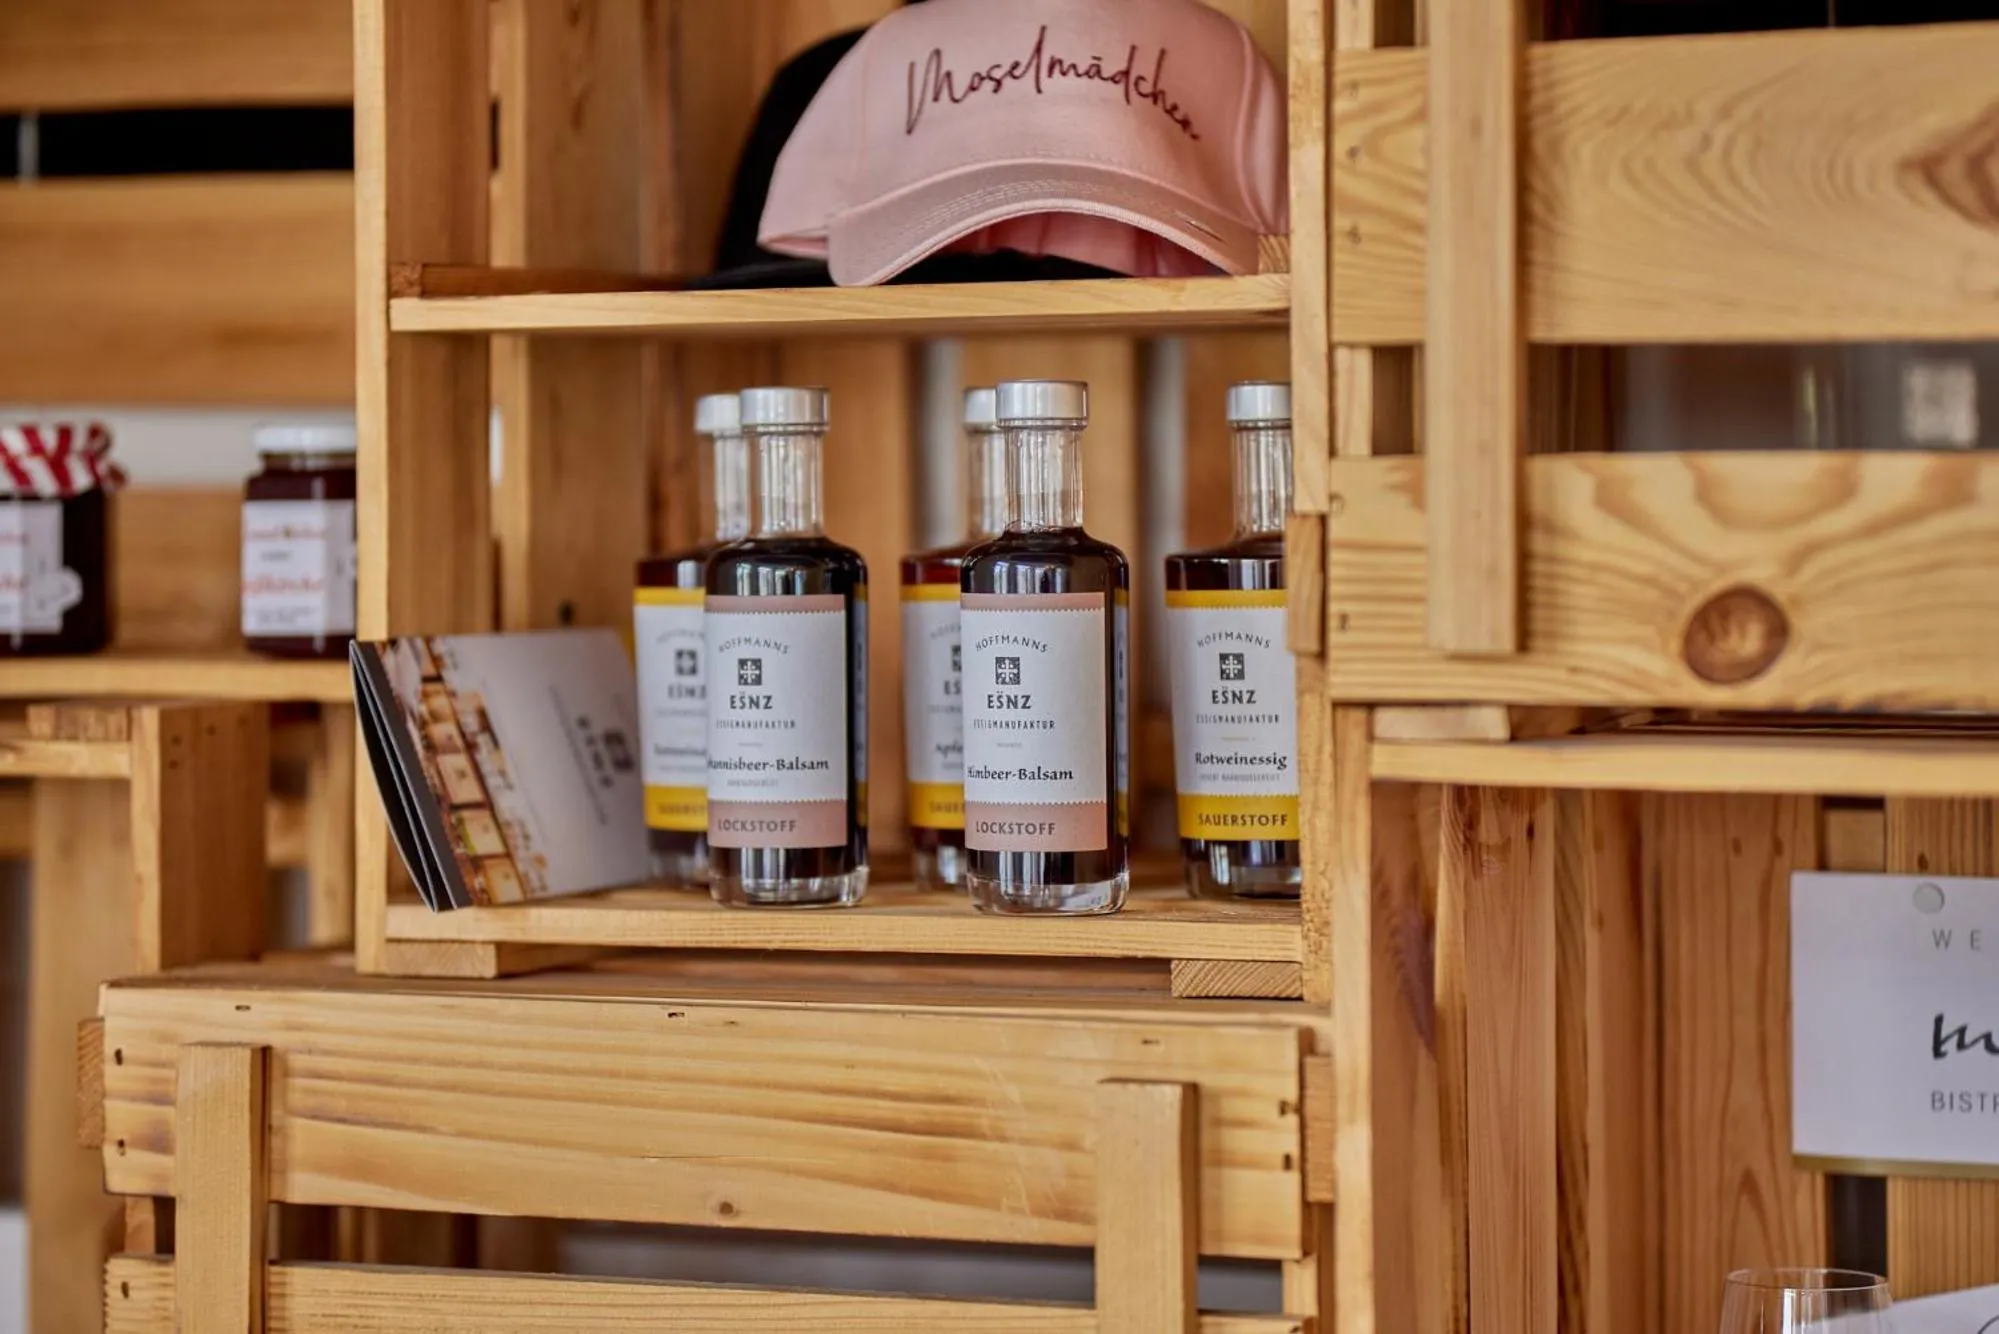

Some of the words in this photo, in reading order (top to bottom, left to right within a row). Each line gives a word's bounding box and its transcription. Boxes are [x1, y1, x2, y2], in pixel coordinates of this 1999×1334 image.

[718, 636, 790, 655] HOFFMANNS
[975, 634, 1049, 653] HOFFMANNS
[1197, 631, 1271, 649] HOFFMANNS
[1195, 751, 1287, 771] Rotweinessig
[967, 764, 1074, 781] Himbeer-Balsam
[718, 818, 797, 832] LOCKSTOFF
[975, 820, 1056, 836] LOCKSTOFF
[1198, 813, 1289, 827] SAUERSTOFF
